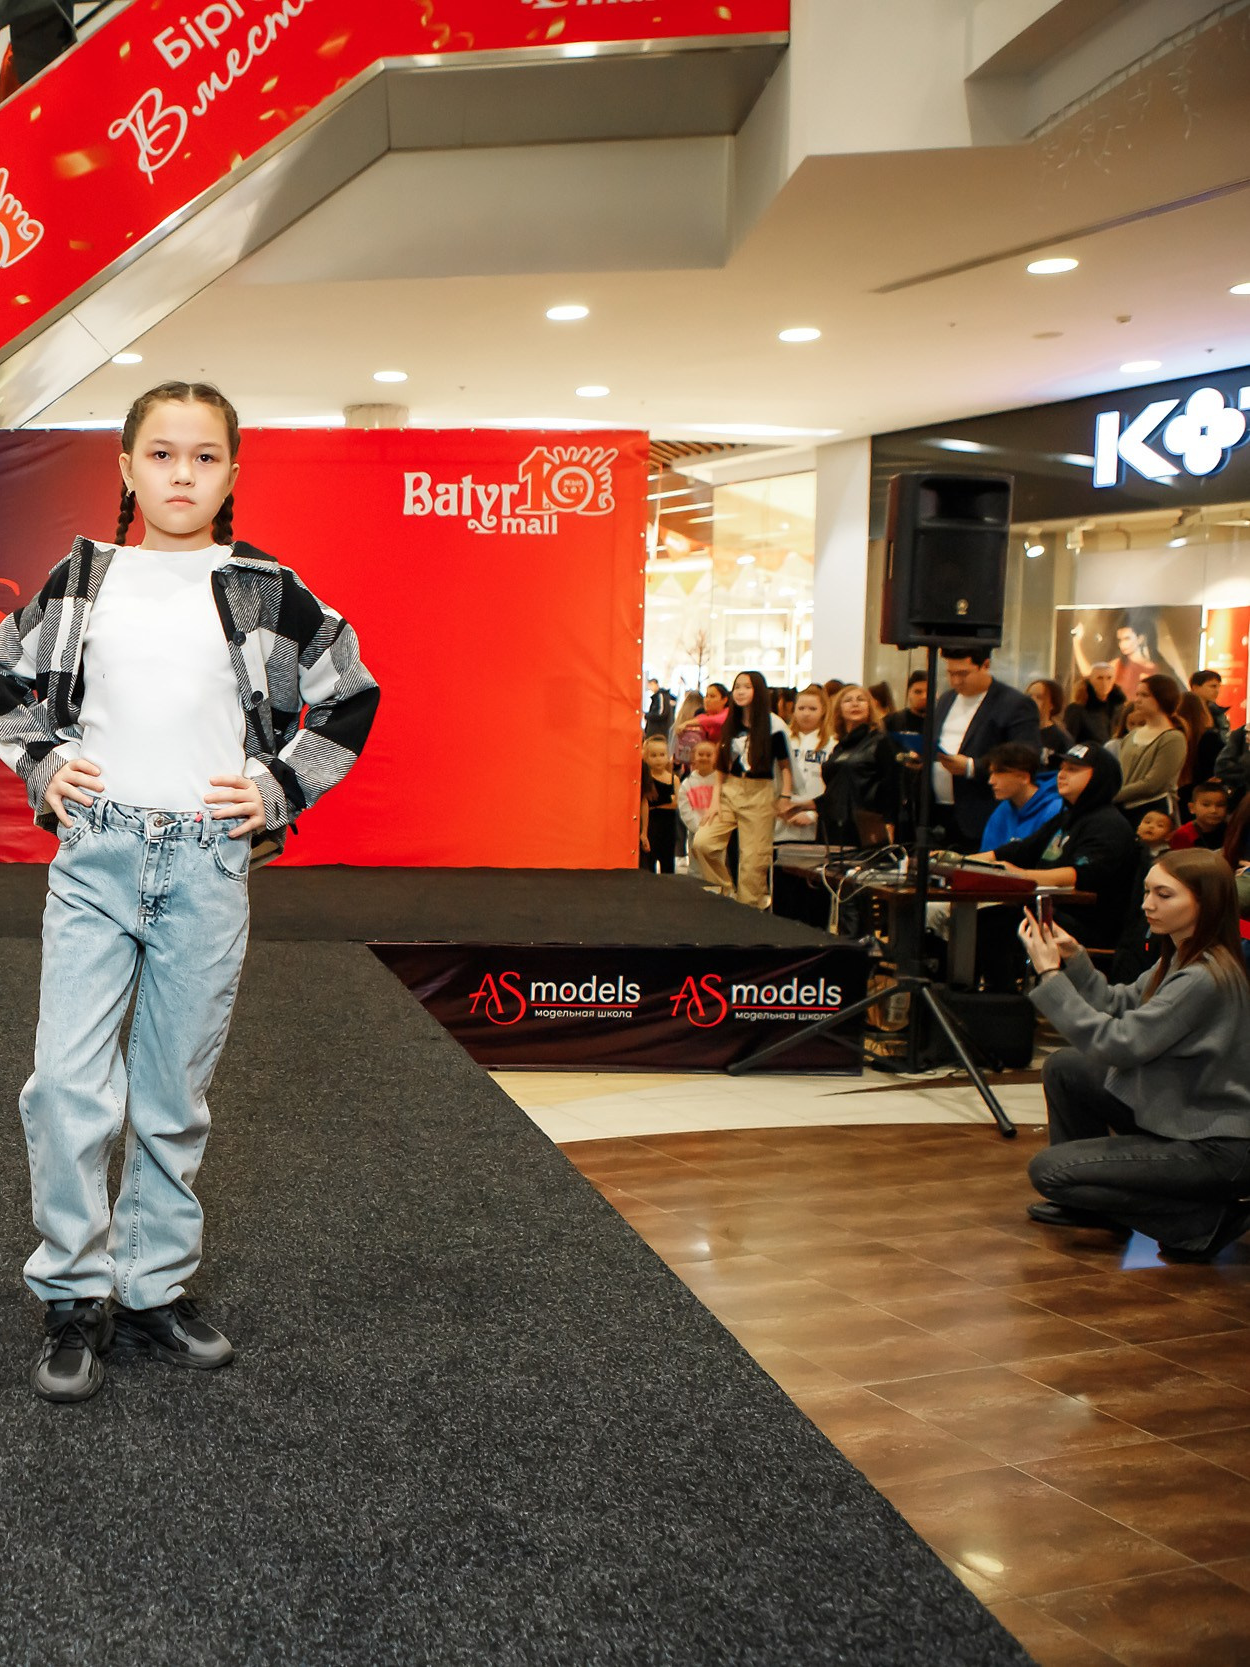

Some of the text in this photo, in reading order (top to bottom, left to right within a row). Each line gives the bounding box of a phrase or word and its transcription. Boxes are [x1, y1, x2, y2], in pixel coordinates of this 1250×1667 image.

[403, 471, 520, 534] Batyr
[501, 514, 558, 535] mall
[469, 971, 641, 1025] AS models
[534, 1009, 632, 1019] модельная школа
[669, 973, 842, 1028] AS models
[735, 1011, 796, 1022] модельная
